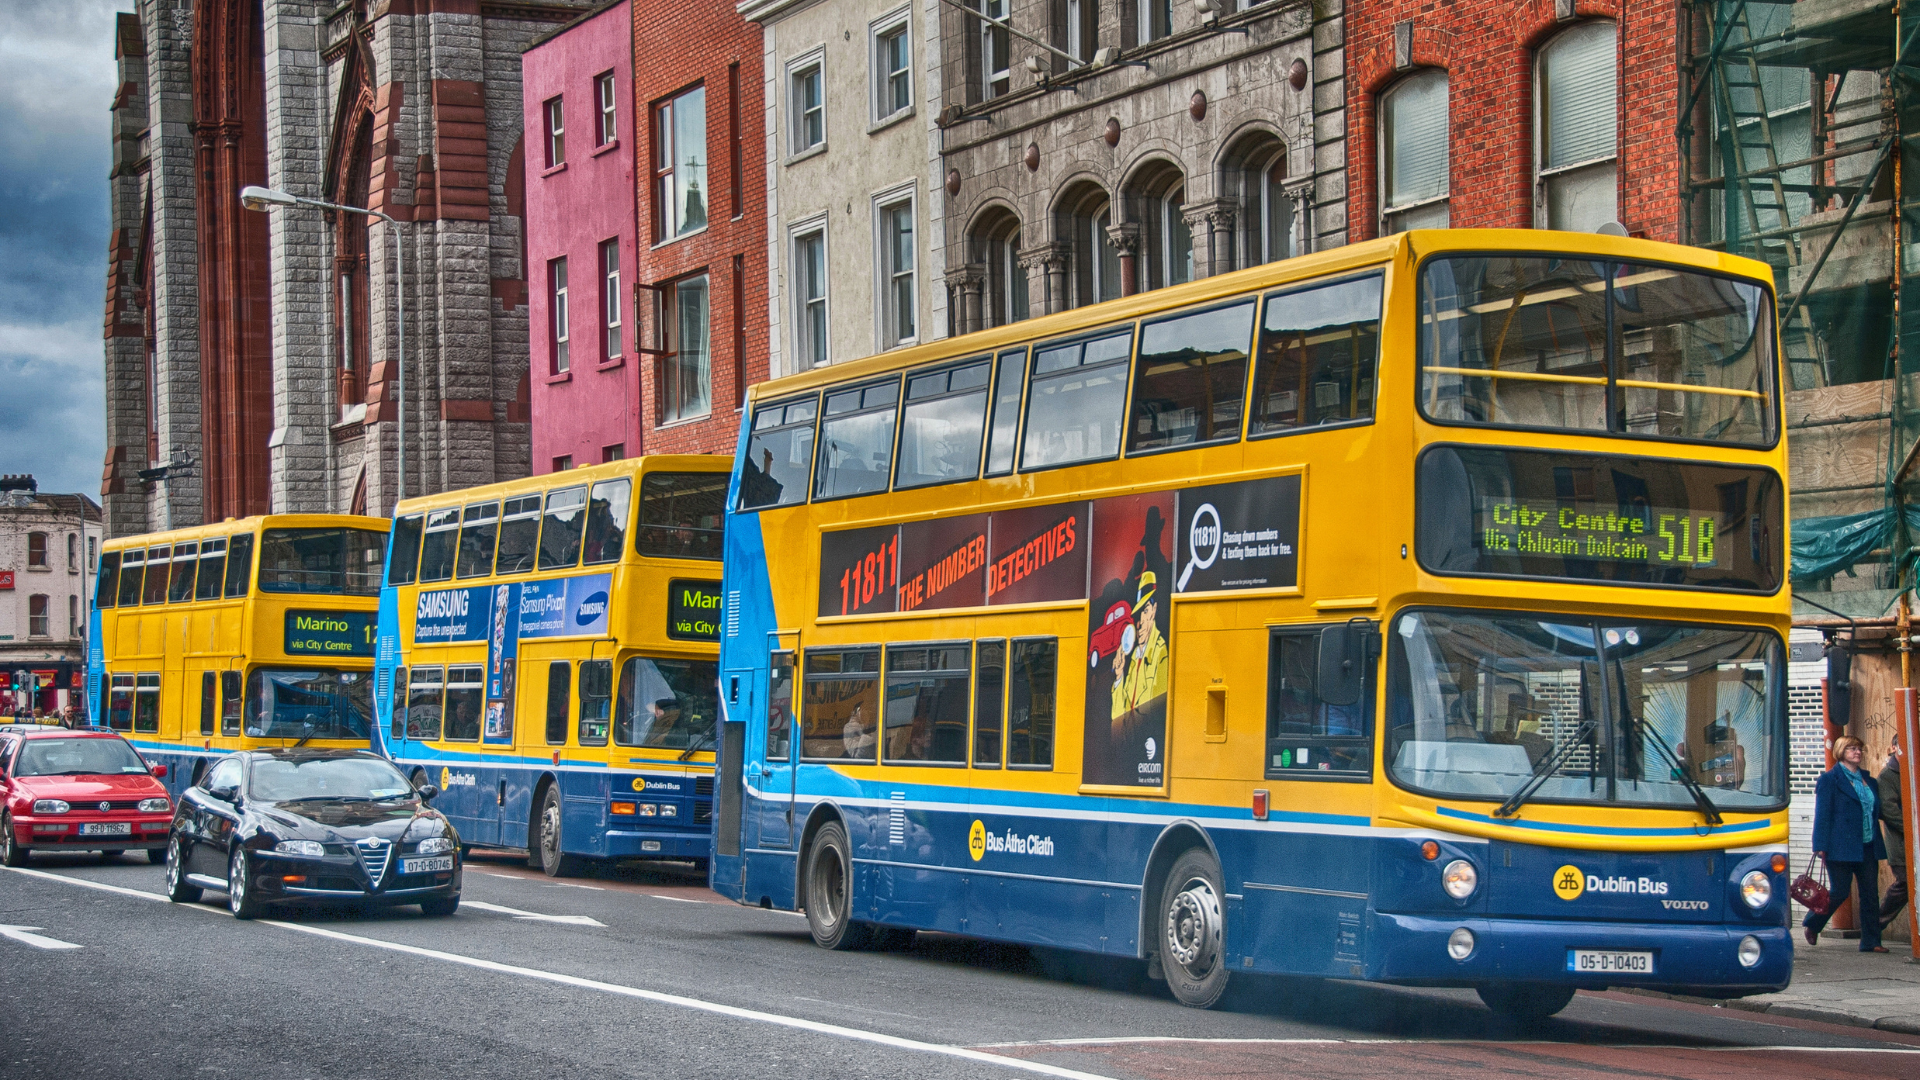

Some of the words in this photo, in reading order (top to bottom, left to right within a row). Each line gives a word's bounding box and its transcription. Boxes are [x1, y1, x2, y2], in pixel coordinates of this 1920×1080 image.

[1194, 526, 1216, 546] 11811
[1222, 531, 1242, 545] Chasing
[1242, 530, 1256, 543] down
[1256, 528, 1278, 541] numbers
[1485, 528, 1509, 551] Via
[1517, 530, 1579, 555] Chluain
[1493, 503, 1548, 526] City
[1558, 507, 1644, 533] Centre
[1658, 514, 1714, 563] 51B
[1222, 547, 1227, 559] &
[1227, 546, 1244, 560] texting
[1244, 545, 1257, 558] them
[1258, 544, 1270, 556] back
[1270, 543, 1279, 555] for
[1279, 542, 1292, 555] free.
[899, 573, 924, 612] THE
[926, 534, 986, 599] NUMBER
[988, 515, 1076, 597] DETECTIVES
[840, 533, 898, 615] 11811
[418, 589, 469, 619] SAMSUNG
[521, 596, 546, 616] Samsung
[546, 594, 566, 612] Pixon
[580, 602, 605, 615] SAMSUNG
[296, 616, 349, 631] Marino
[416, 624, 433, 639] Capture
[433, 623, 441, 636] the
[441, 622, 467, 637] unexpected
[677, 619, 692, 632] via
[694, 620, 715, 635] City
[292, 639, 304, 649] via
[306, 639, 322, 651] City
[325, 640, 352, 651] Centre
[646, 781, 667, 790] Dublin
[667, 782, 680, 790] Bus
[986, 831, 1004, 852] Bus
[1004, 828, 1026, 853] Átha
[1027, 834, 1054, 856] Cliath
[1586, 875, 1636, 893] Dublin
[1638, 877, 1668, 894] Bus
[1661, 899, 1709, 910] VOLVO
[1581, 954, 1646, 971] 05-D-10403
